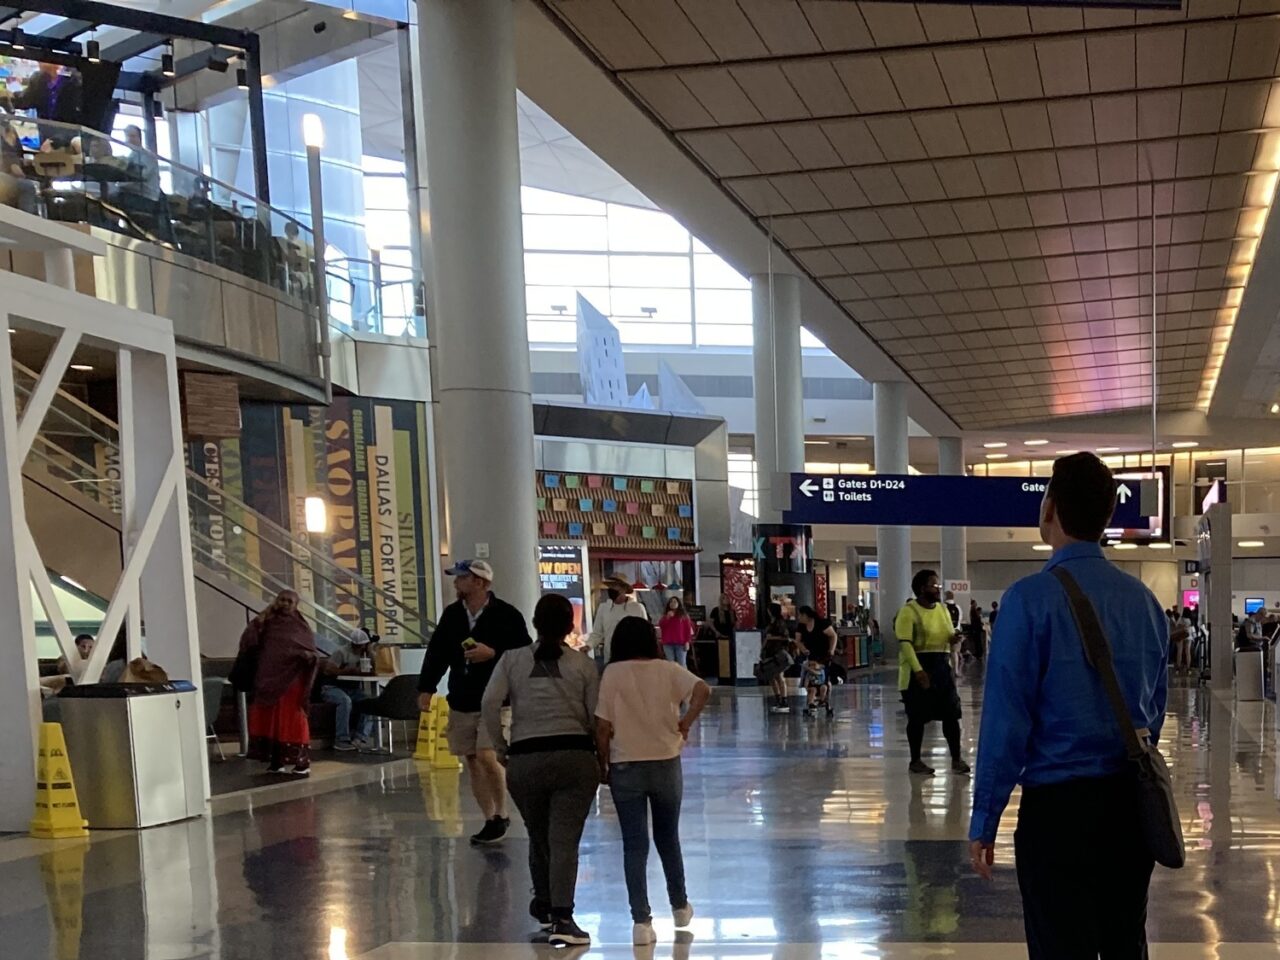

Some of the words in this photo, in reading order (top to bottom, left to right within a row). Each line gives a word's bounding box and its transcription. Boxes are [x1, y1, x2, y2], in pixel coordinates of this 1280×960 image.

[375, 455, 392, 516] DALLAS
[838, 479, 867, 490] Gates
[870, 480, 905, 490] D1-D24
[838, 491, 872, 502] Toilets
[379, 535, 395, 574] FORT
[554, 562, 582, 574] OPEN
[951, 583, 968, 592] D30
